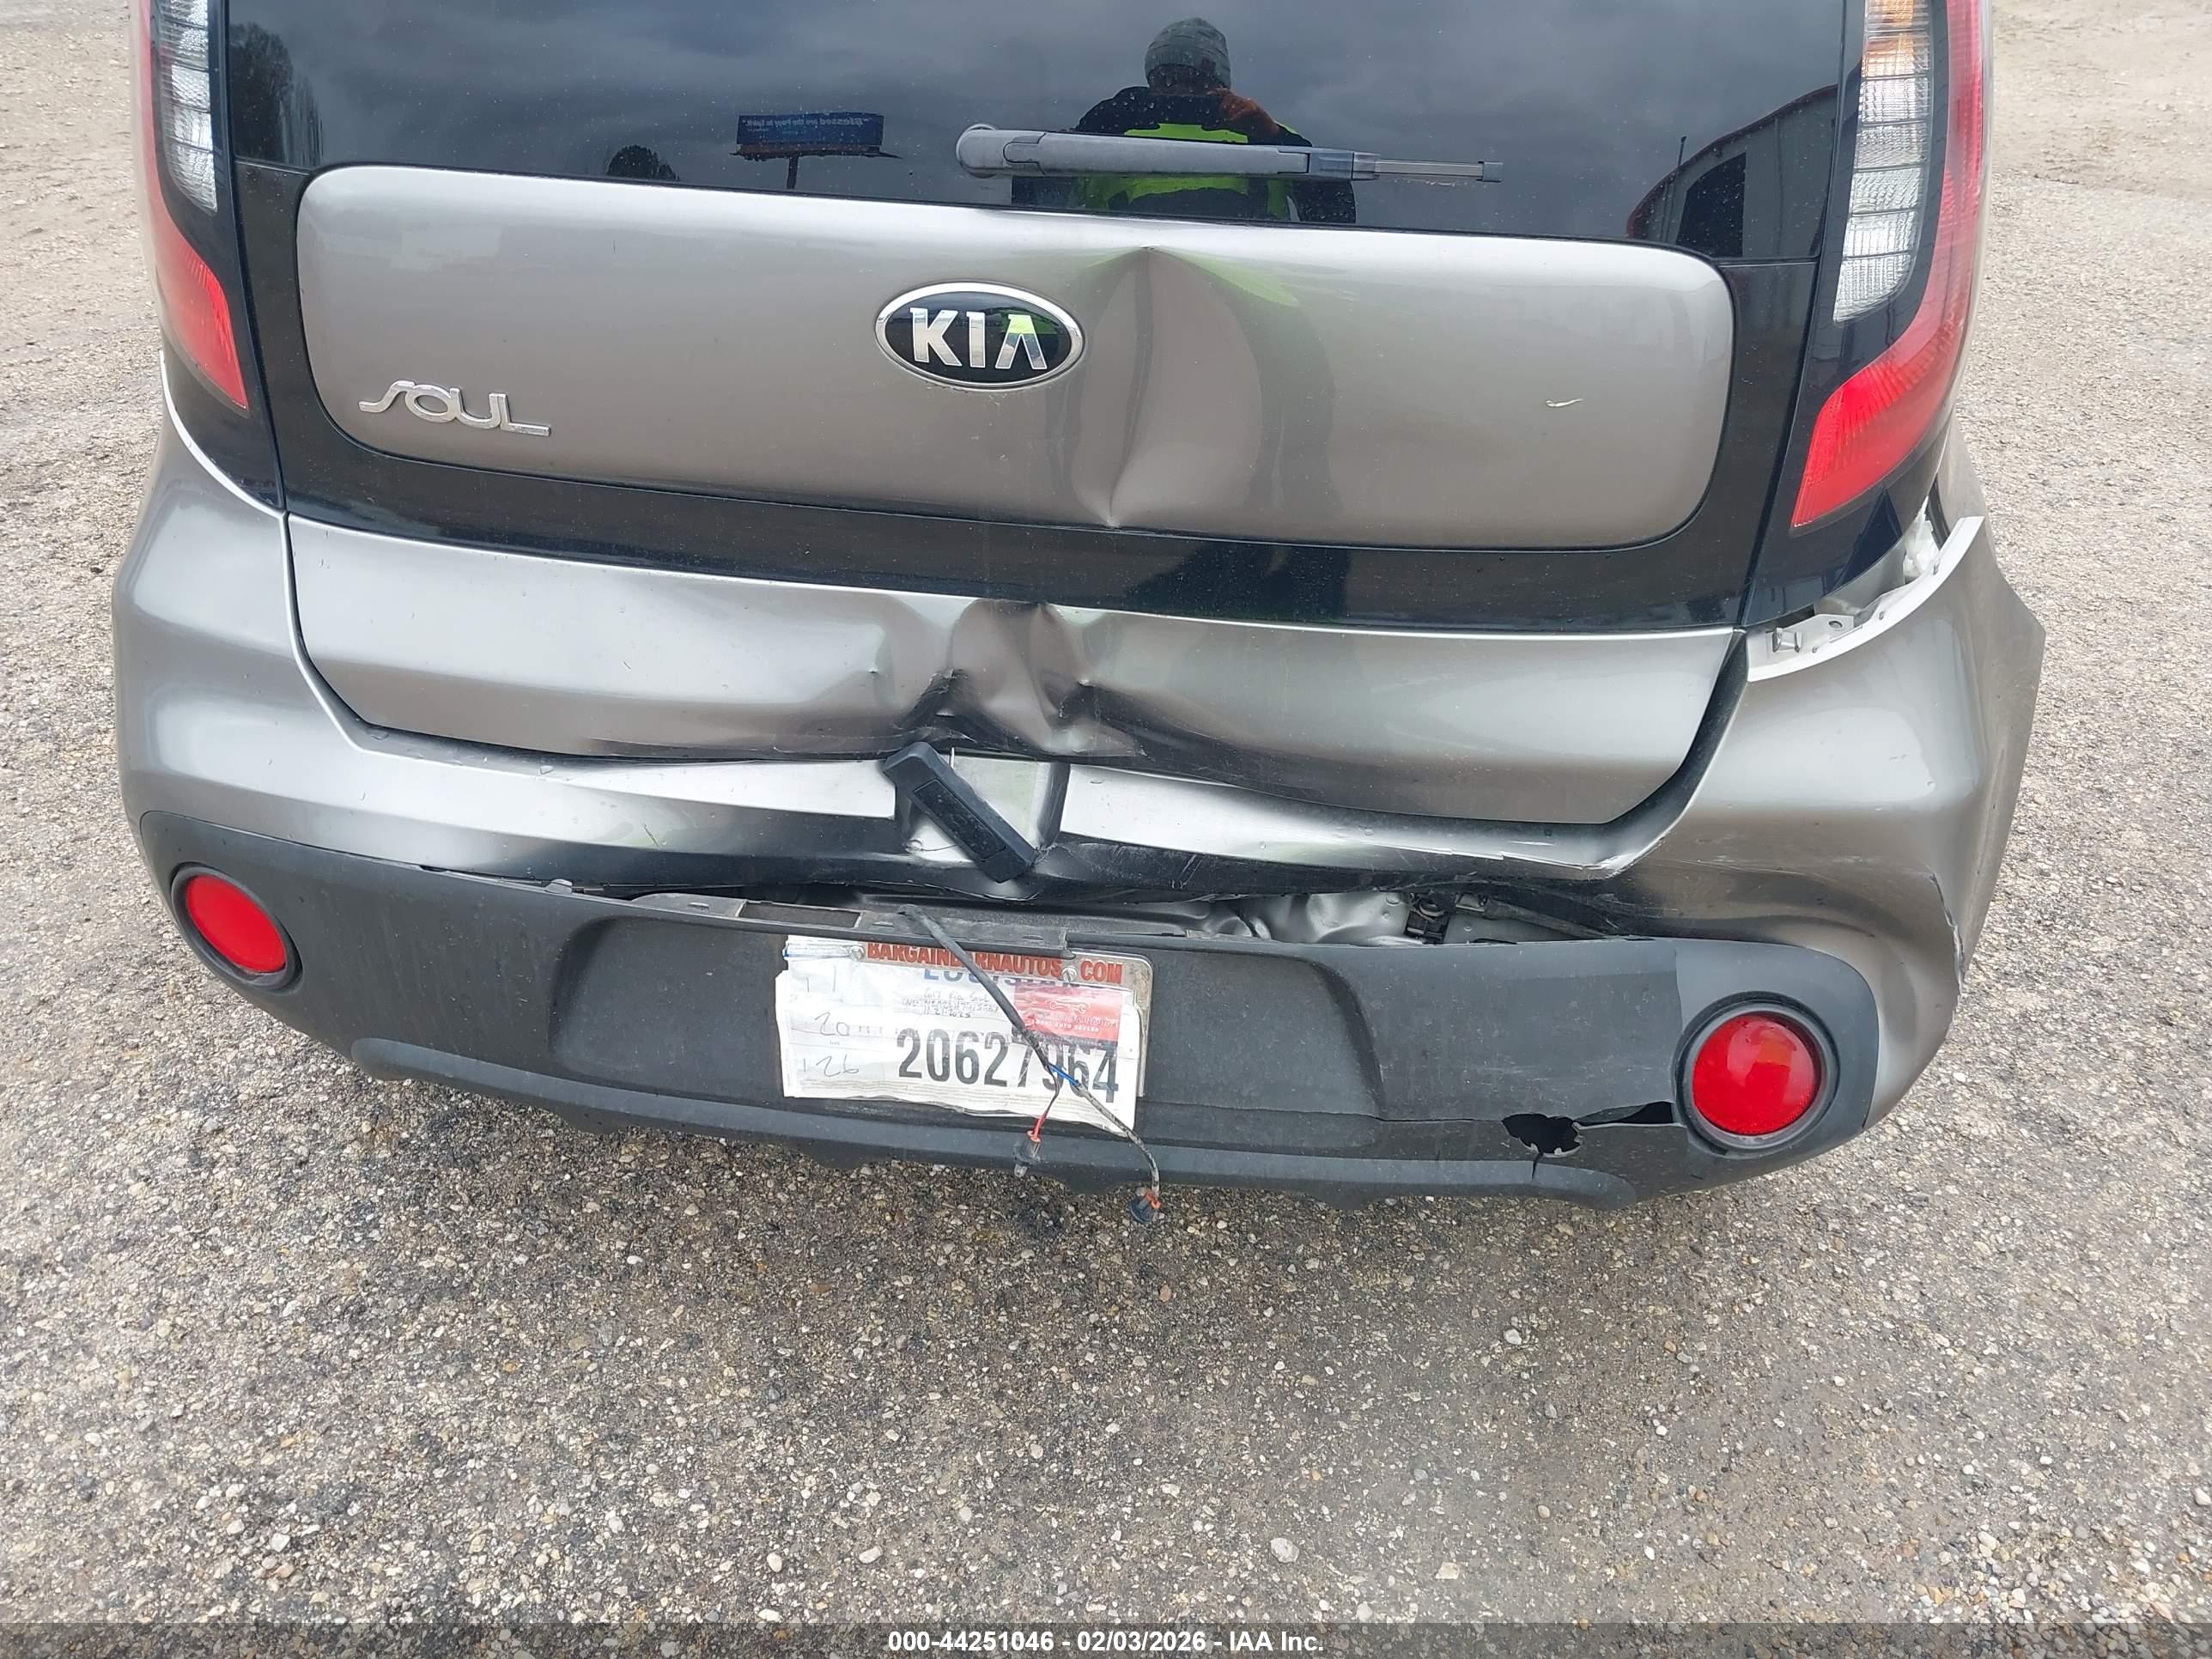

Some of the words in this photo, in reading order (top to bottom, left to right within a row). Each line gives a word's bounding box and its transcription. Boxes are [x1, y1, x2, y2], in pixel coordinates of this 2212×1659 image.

[909, 307, 1048, 371] KIA
[358, 379, 551, 437] SOUL
[866, 941, 1063, 978] BARGAINBRNAUTOS
[814, 1011, 851, 1037] 20
[896, 1028, 1119, 1103] 20627964
